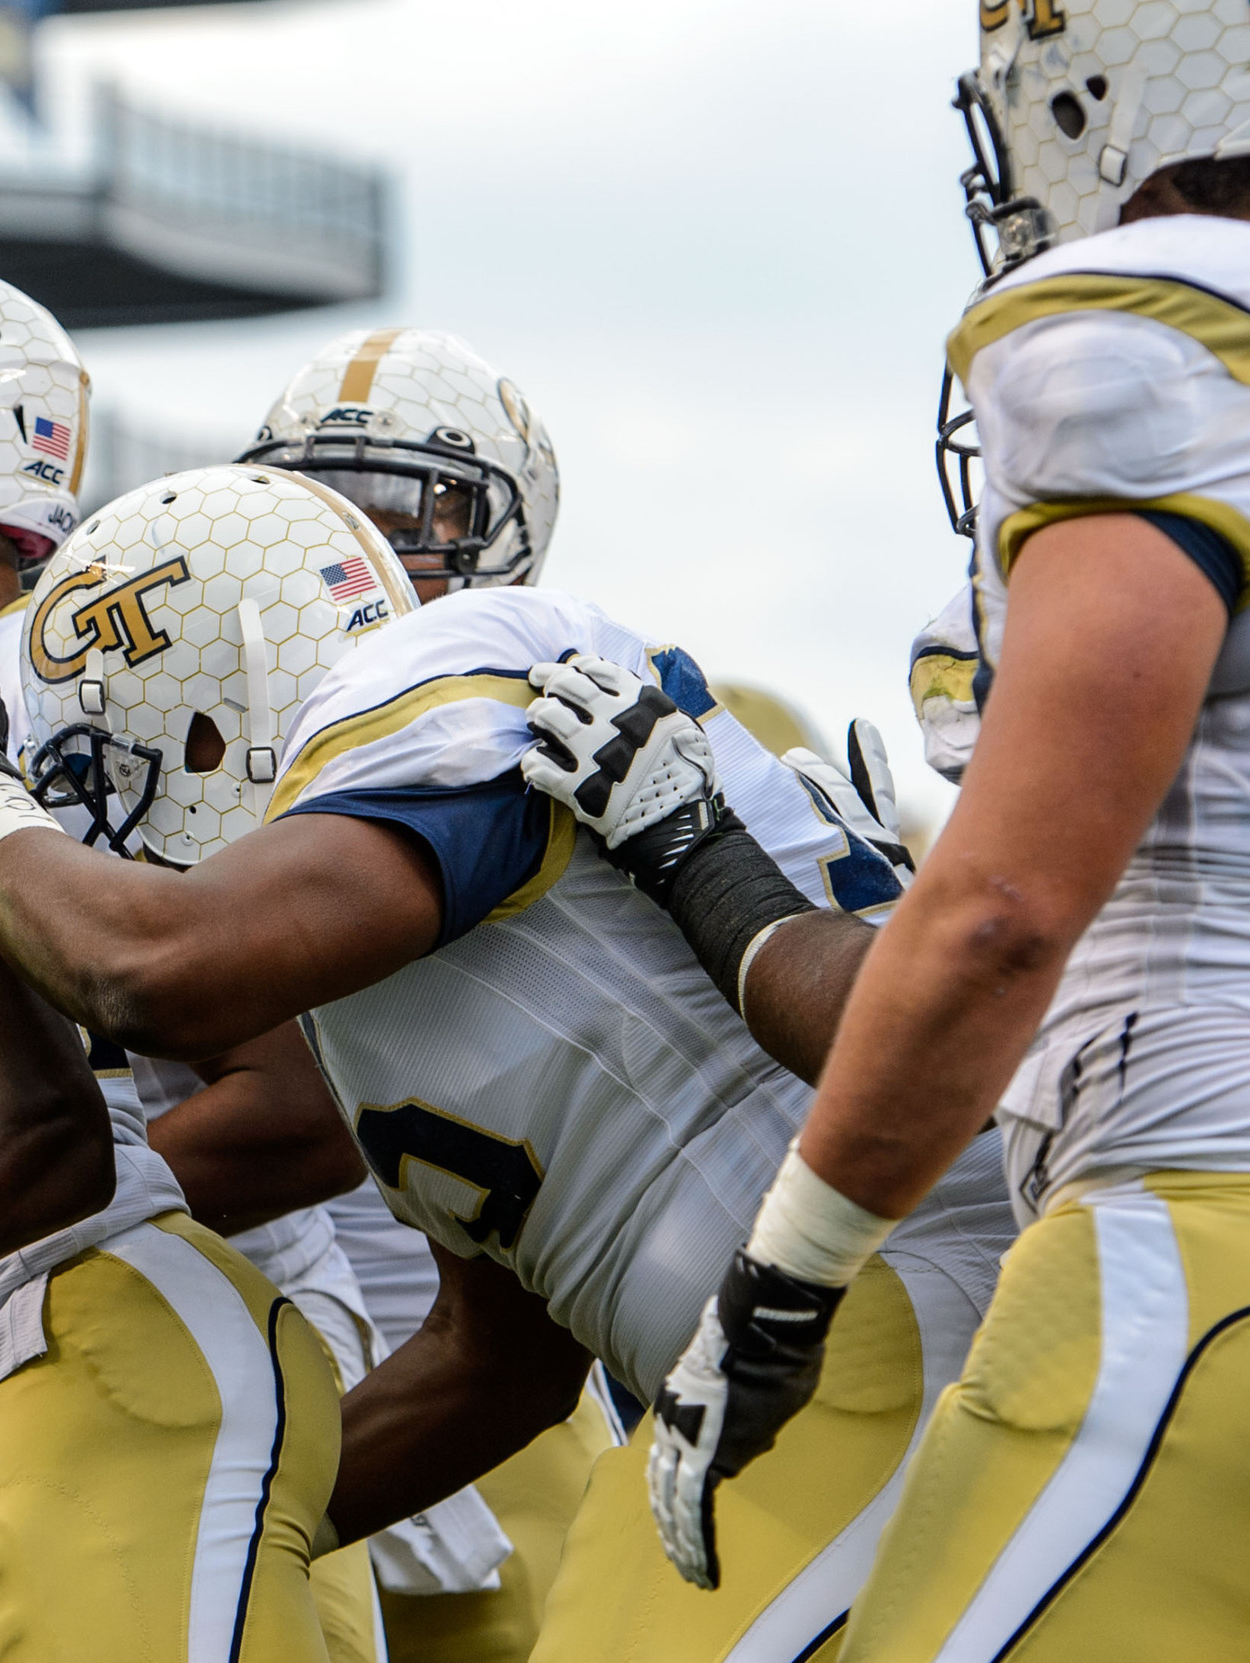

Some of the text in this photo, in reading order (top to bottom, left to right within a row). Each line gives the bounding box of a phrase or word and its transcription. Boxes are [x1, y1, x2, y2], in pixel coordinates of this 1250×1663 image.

[320, 408, 374, 424] ACC
[23, 460, 65, 485] ACC
[29, 555, 191, 685] GT
[346, 599, 389, 632] ACC
